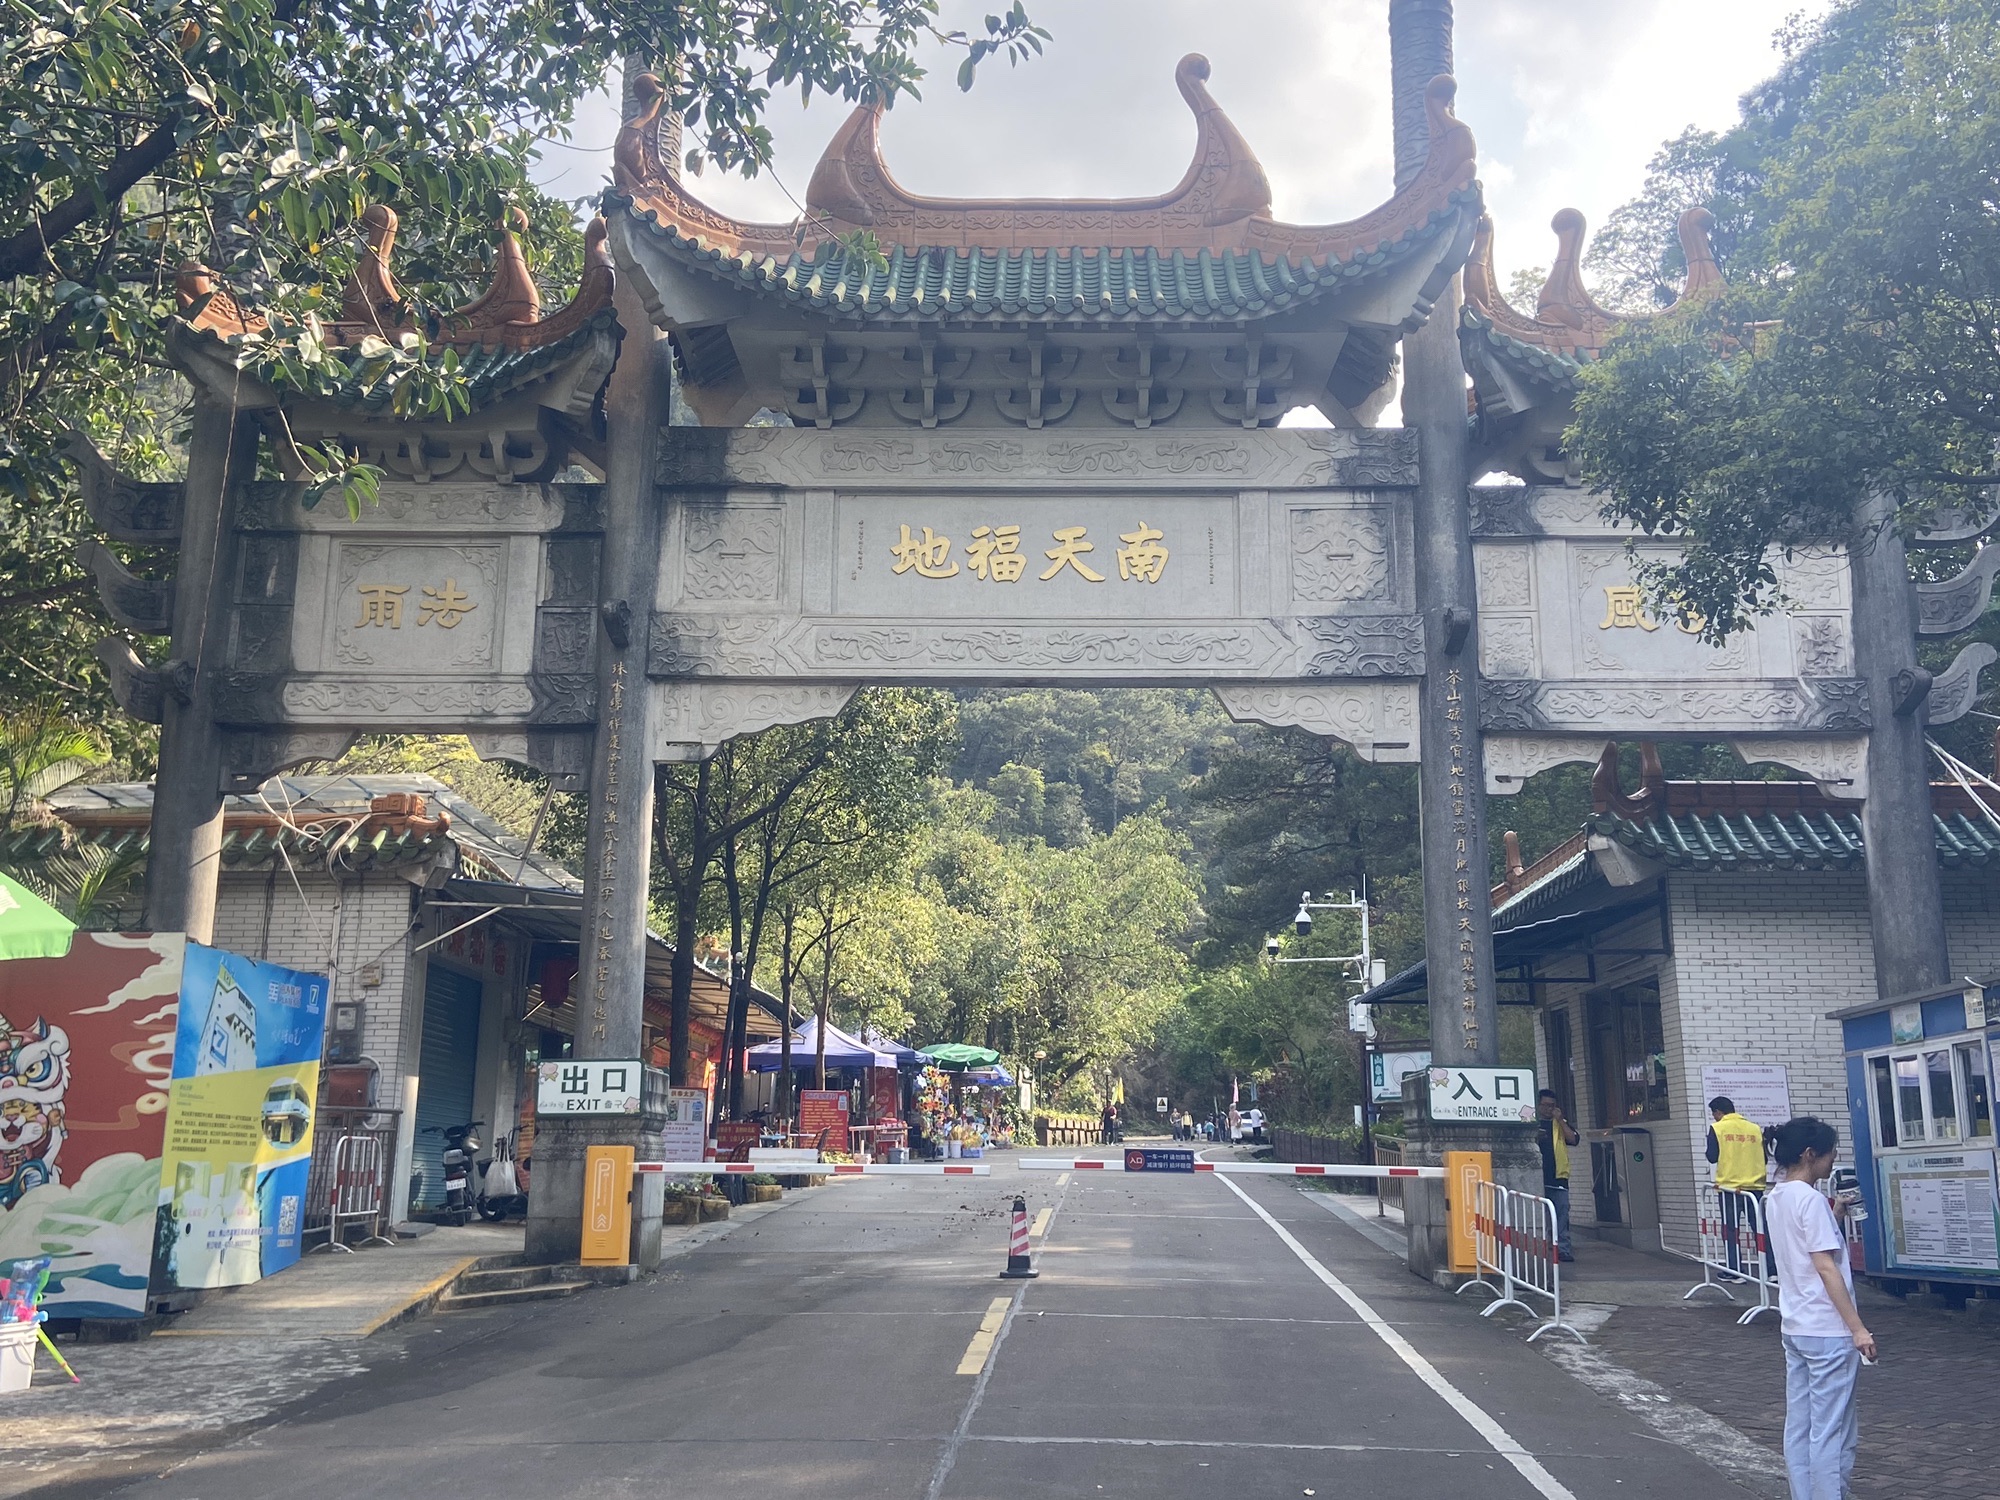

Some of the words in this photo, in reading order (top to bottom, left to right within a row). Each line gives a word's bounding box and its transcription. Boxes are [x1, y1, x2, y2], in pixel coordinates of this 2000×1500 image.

[891, 521, 1170, 584] 南天福地
[354, 577, 478, 629] 法雨
[561, 1065, 627, 1094] 出口
[1451, 1072, 1520, 1101] 入口
[566, 1099, 601, 1110] EXIT
[1458, 1106, 1498, 1118] ENTRANCE
[1501, 1107, 1518, 1117] 입구
